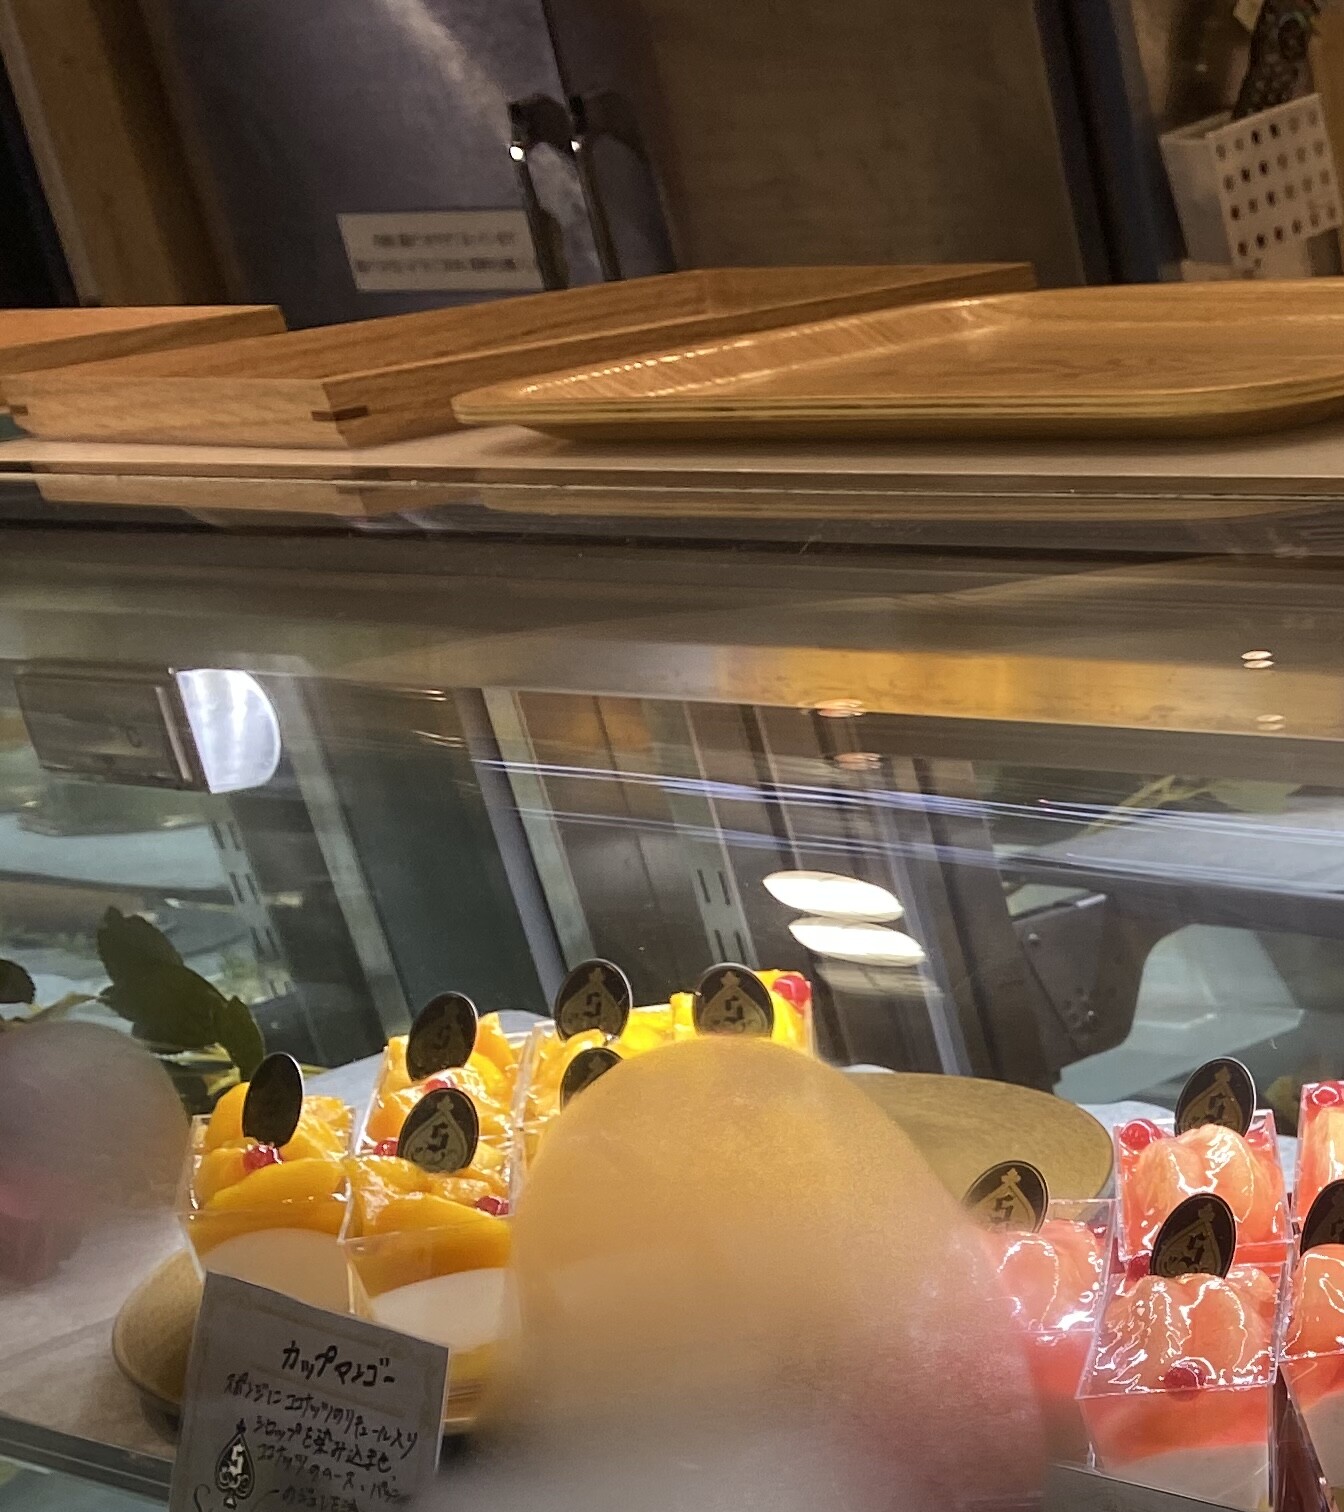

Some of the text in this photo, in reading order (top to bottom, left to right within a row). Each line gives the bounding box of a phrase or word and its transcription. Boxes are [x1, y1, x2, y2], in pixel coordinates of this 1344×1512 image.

[282, 1341, 396, 1384] カップマンゴー
